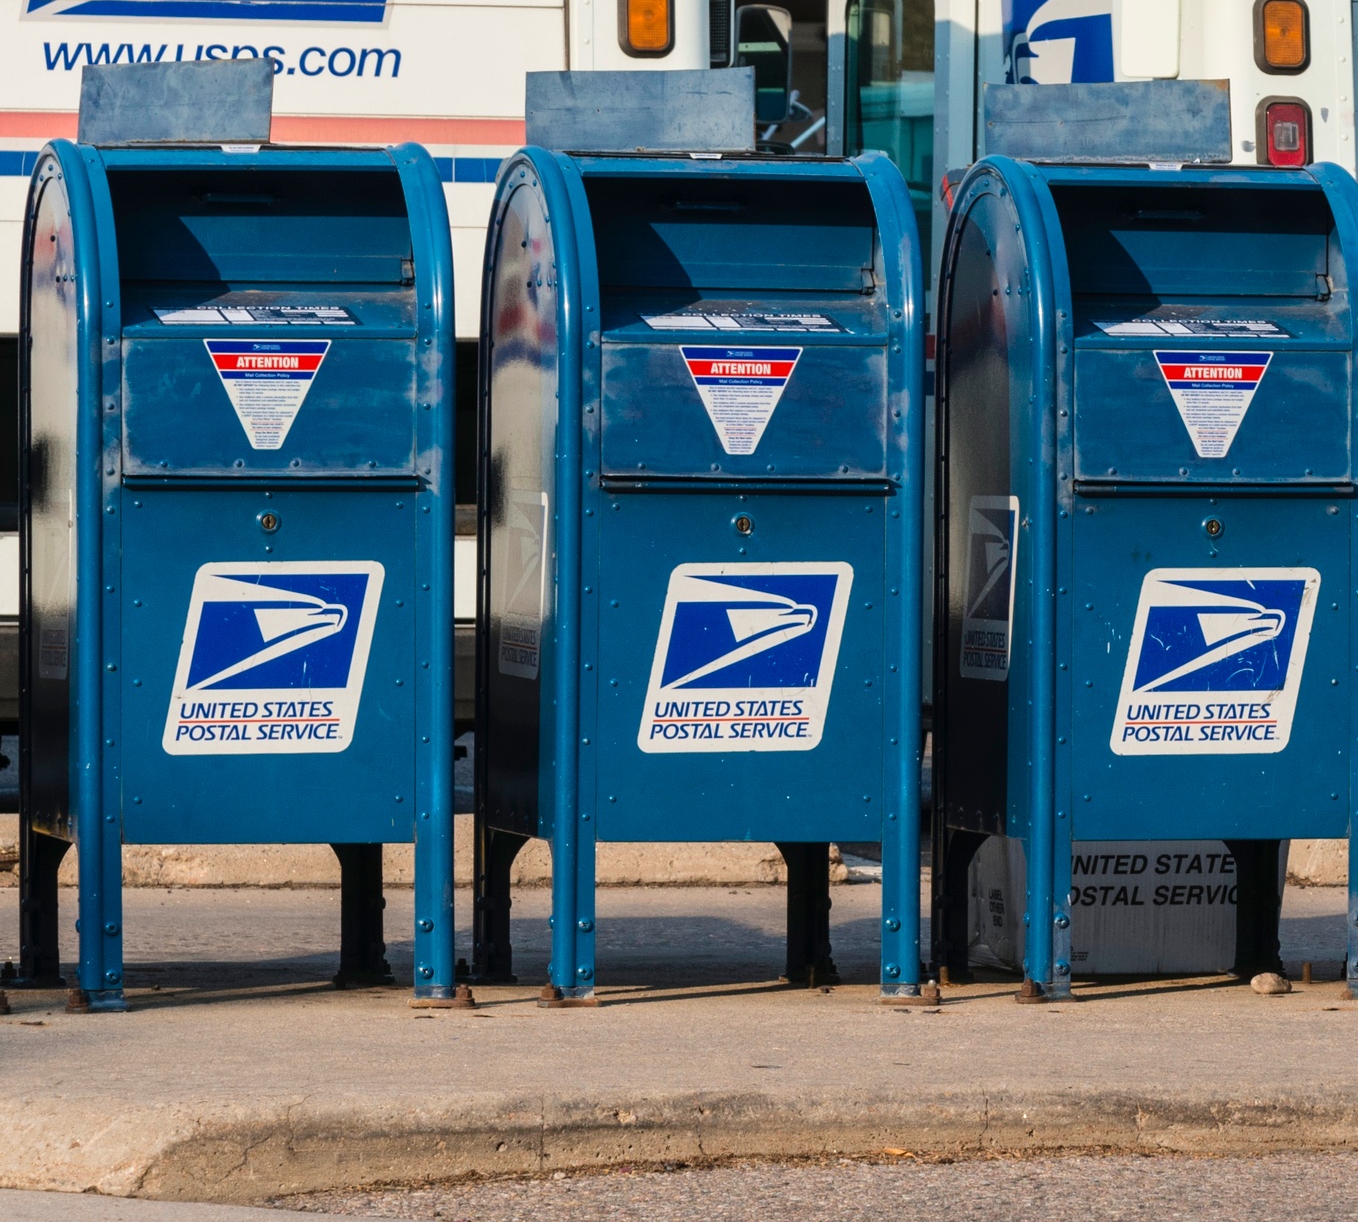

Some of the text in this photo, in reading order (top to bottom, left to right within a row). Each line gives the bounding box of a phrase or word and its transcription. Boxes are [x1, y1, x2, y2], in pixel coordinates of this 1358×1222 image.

[236, 356, 299, 369] ATTENTION
[710, 363, 771, 375] ATTENTION
[1183, 367, 1243, 379] ATTENTION
[180, 701, 333, 718] UNITED STATES
[654, 700, 804, 717] UNITED STATES
[1126, 702, 1271, 720] UNITED STATES
[175, 724, 252, 741] POSTAL
[649, 723, 725, 740] POSTAL
[1122, 725, 1195, 742] POSTAL
[1071, 854, 1148, 875] NITED
